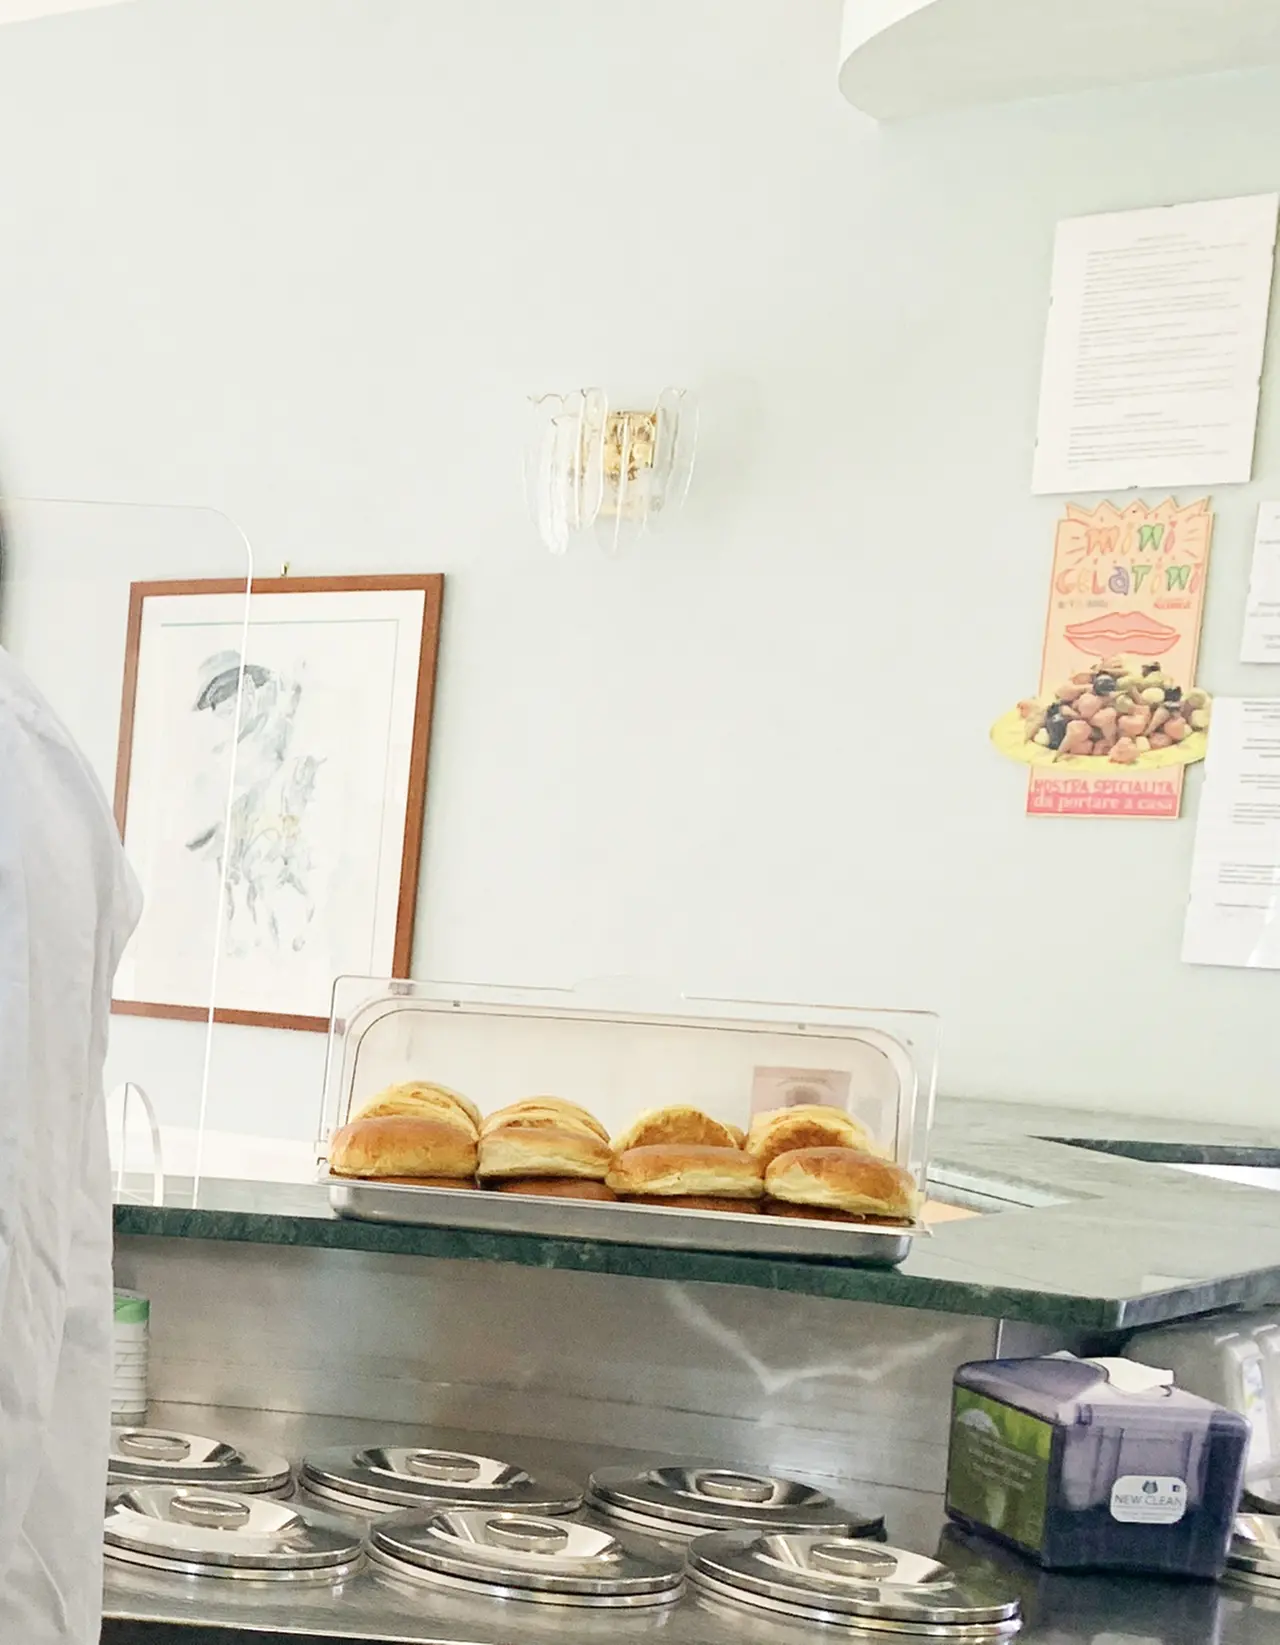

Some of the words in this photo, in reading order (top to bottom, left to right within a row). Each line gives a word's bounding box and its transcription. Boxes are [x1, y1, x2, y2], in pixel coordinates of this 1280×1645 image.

[1034, 786, 1053, 808] da
[1058, 795, 1120, 813] portare
[1115, 1494, 1143, 1505] NEW
[1144, 1494, 1182, 1506] CLEAN
